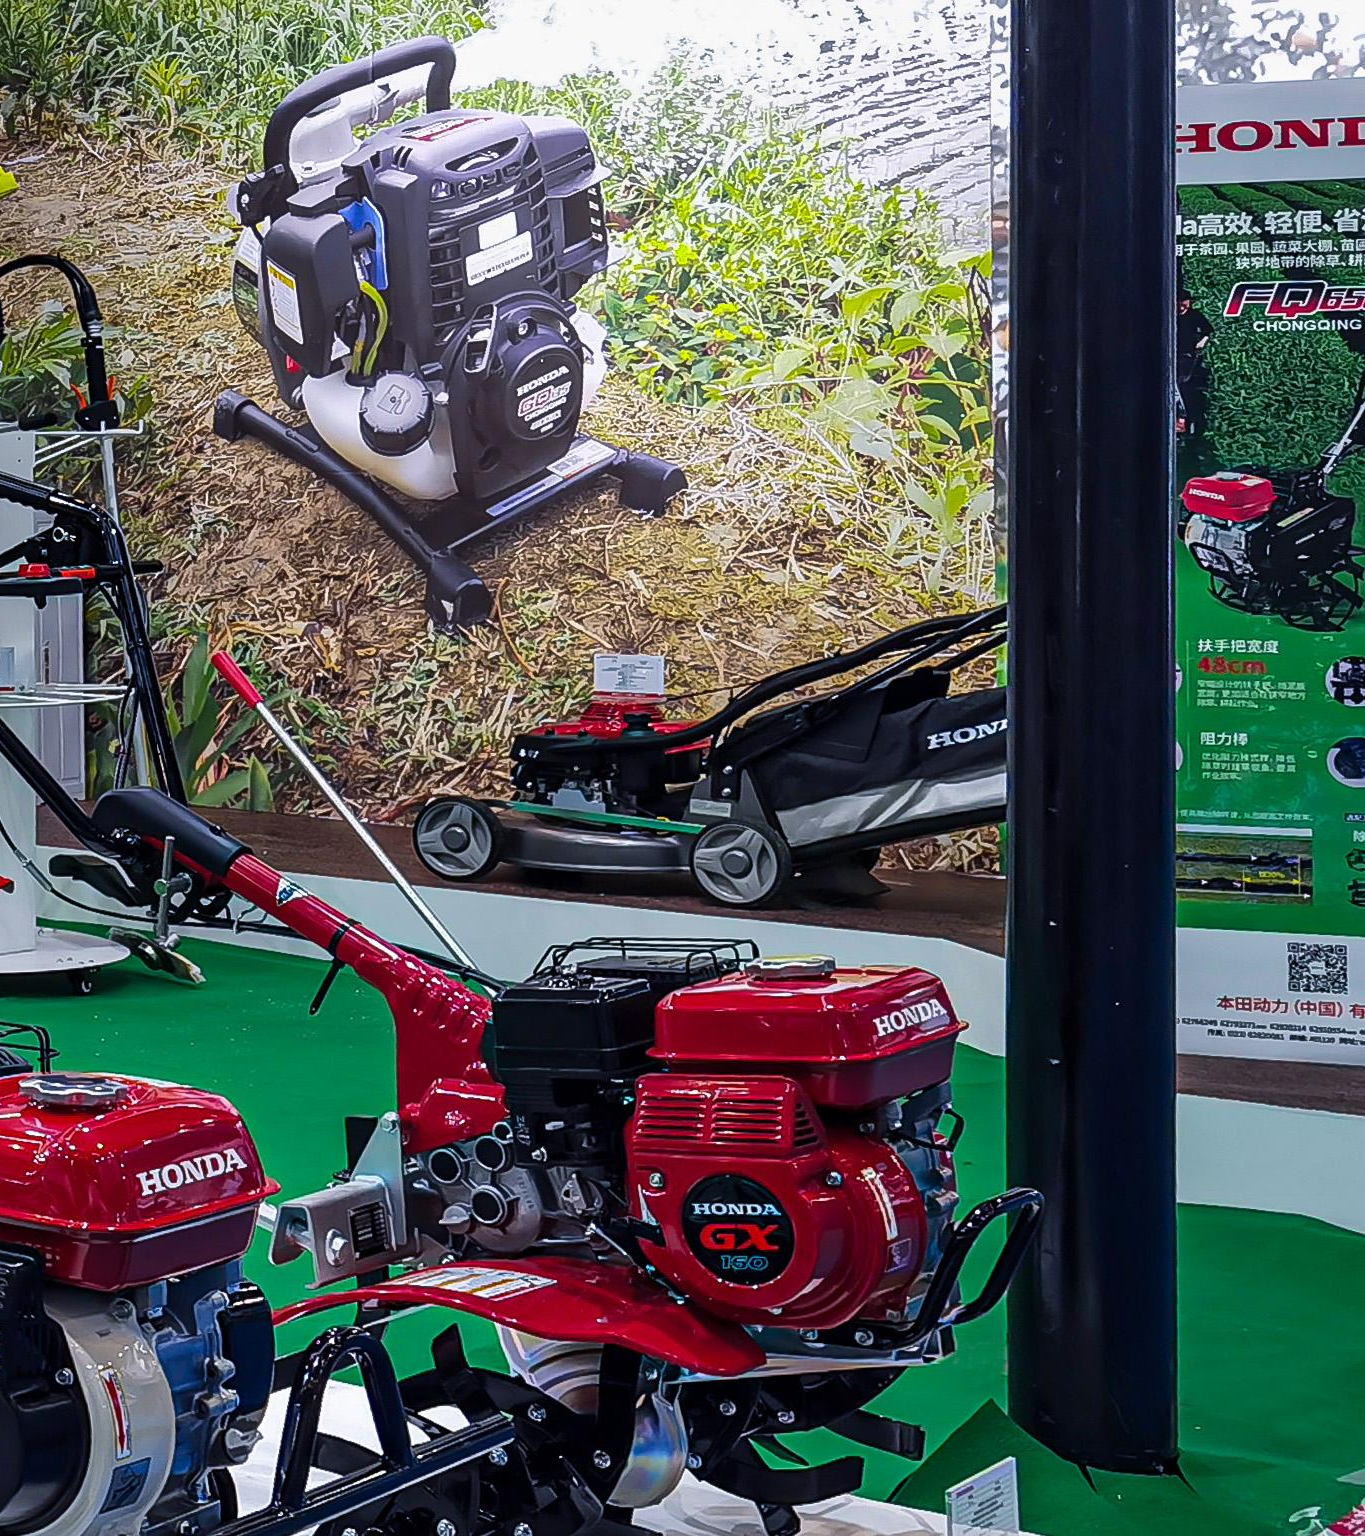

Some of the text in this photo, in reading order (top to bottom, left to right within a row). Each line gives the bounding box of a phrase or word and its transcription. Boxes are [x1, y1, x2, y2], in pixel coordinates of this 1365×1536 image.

[1224, 280, 1365, 319] FQ65
[1253, 319, 1362, 331] CHONGQING
[517, 366, 569, 396] HONDA
[1189, 487, 1226, 501] HONDA
[1197, 638, 1279, 654] 扶手把宽度
[1197, 656, 1268, 674] 48cm
[1200, 731, 1248, 746] 阻力棒
[872, 998, 947, 1037] HONDA
[135, 1148, 247, 1196] HONDA
[691, 1202, 782, 1216] HONDA
[700, 1223, 780, 1251] GX
[721, 1254, 769, 1271] 160
